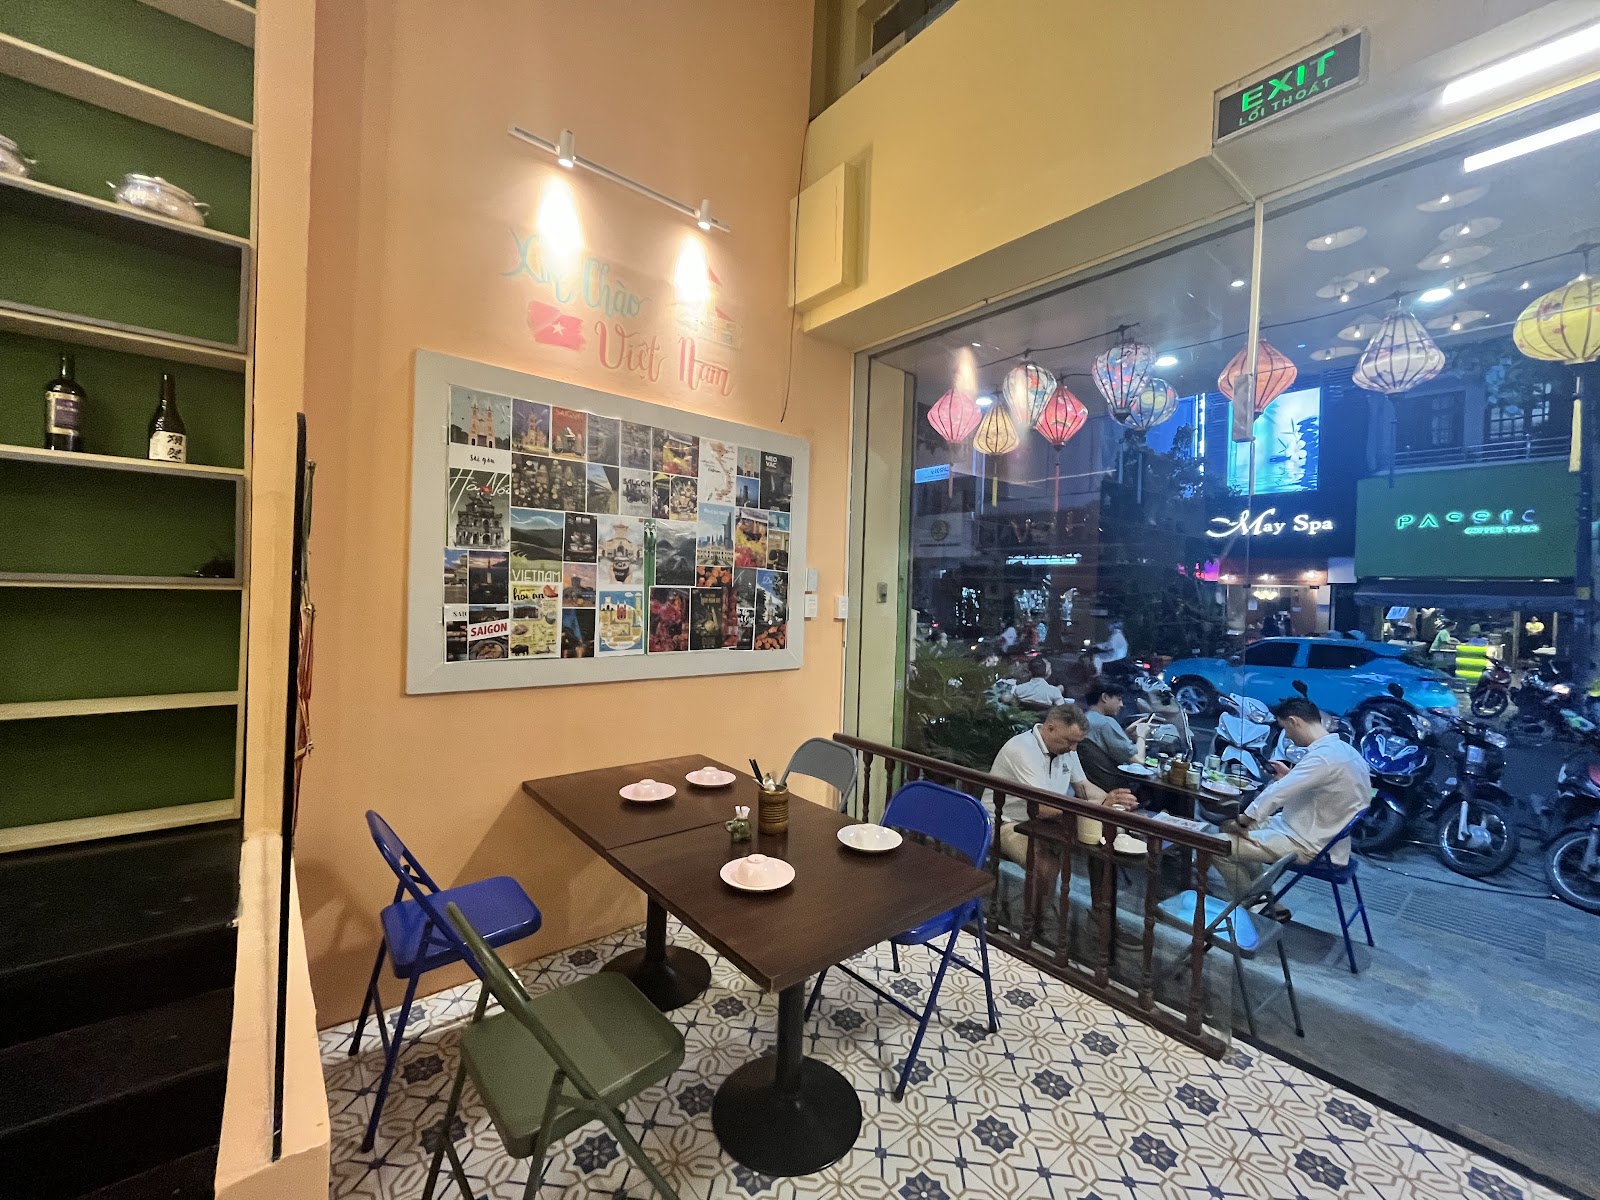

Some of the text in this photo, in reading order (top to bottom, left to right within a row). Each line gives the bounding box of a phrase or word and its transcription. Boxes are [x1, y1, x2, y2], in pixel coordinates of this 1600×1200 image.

[1241, 50, 1335, 112] EXIT
[1271, 76, 1332, 111] THOÁT
[583, 255, 652, 319] Chào
[594, 320, 735, 397] Việt Nam
[1206, 508, 1333, 538] May Spa
[511, 568, 560, 582] VIETNAM
[470, 622, 508, 637] SAIGON
